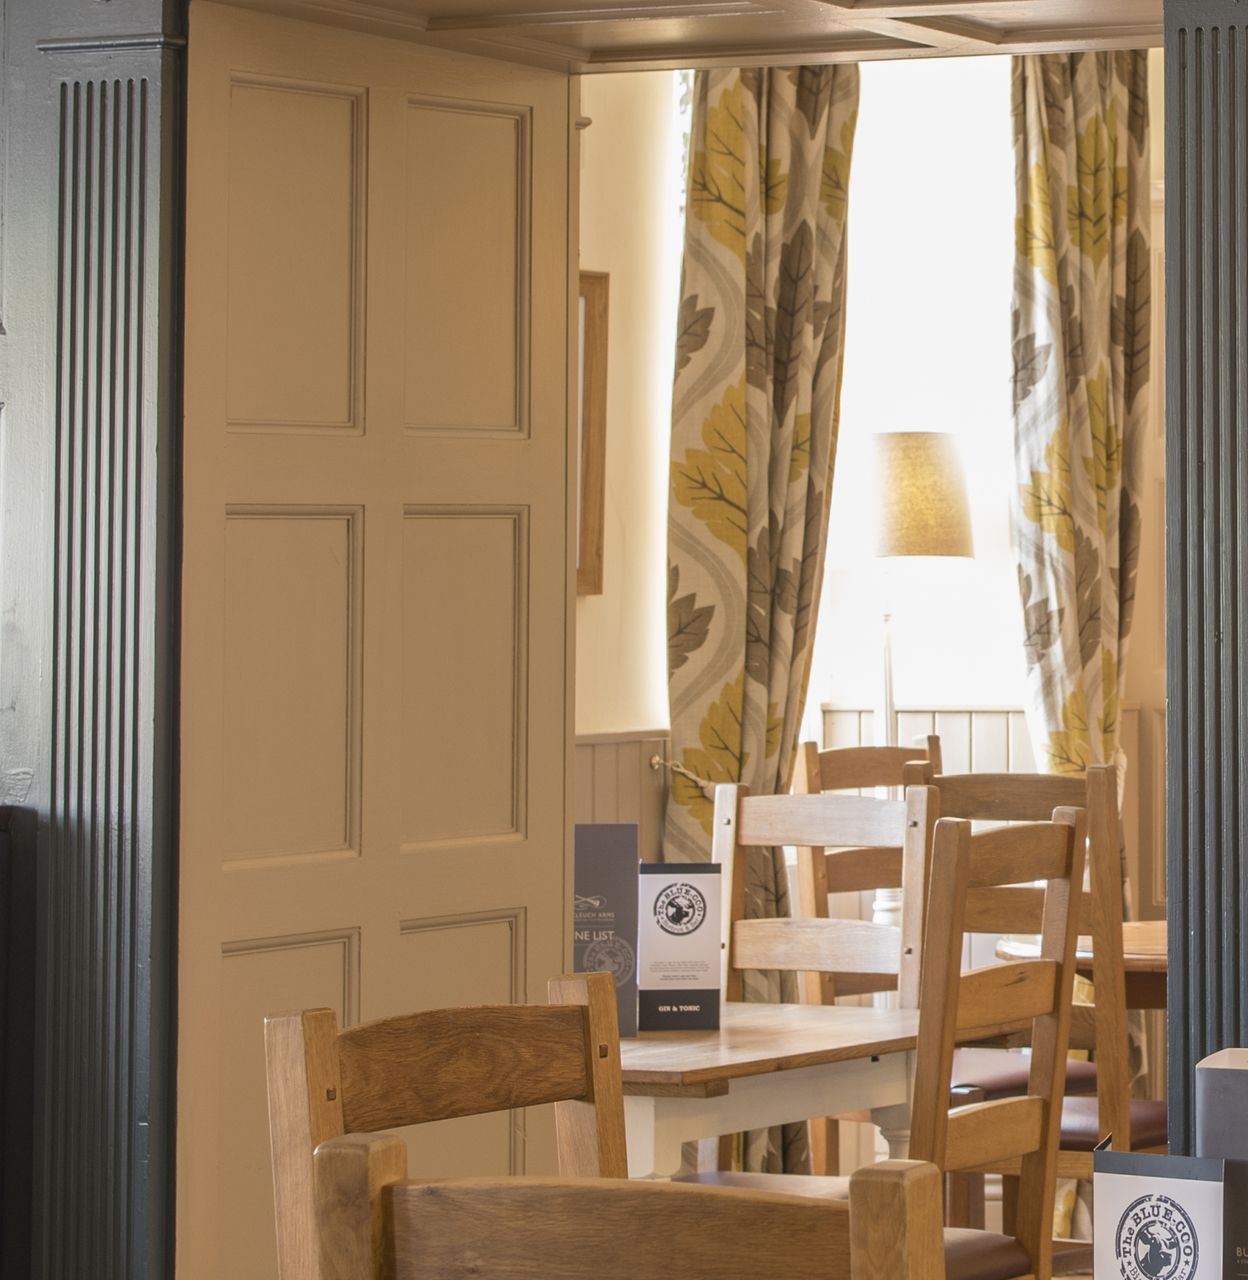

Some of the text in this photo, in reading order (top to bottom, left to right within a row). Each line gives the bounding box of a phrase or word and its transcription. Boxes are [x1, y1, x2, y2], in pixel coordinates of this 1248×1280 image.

[574, 930, 615, 941] NE LIST
[1122, 1204, 1193, 1258] The BLUE-COO
